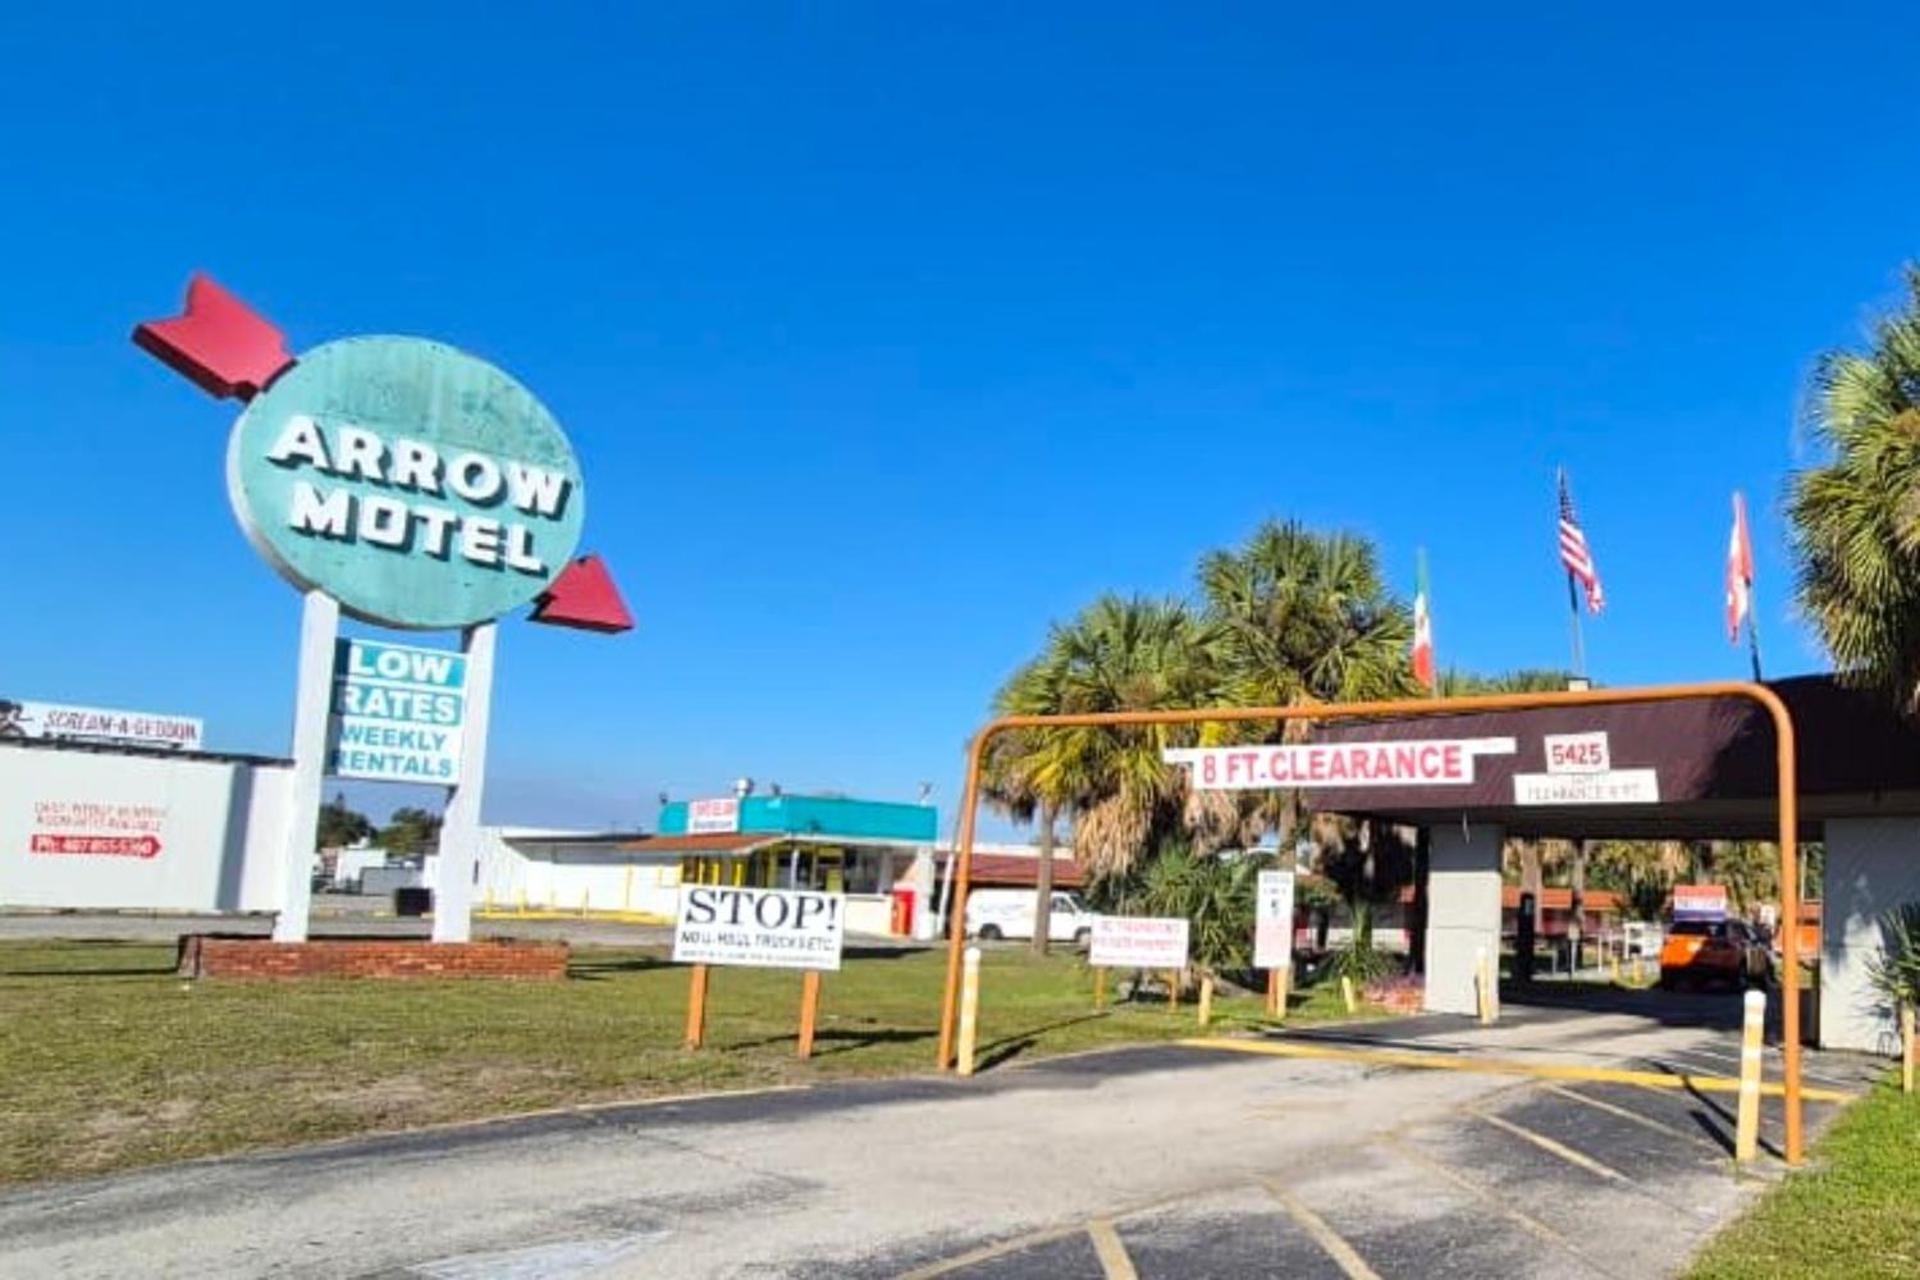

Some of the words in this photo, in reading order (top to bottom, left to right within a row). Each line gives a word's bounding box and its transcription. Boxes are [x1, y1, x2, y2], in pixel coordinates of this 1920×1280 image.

[267, 415, 569, 521] ARROW
[291, 481, 549, 578] MOTEL
[350, 646, 450, 684] LOW
[341, 725, 446, 750] WEEKLY
[1552, 743, 1603, 766] 5425
[1203, 755, 1216, 784] 8
[1269, 744, 1463, 781] CLEARANCE
[685, 887, 836, 932] STOP!
